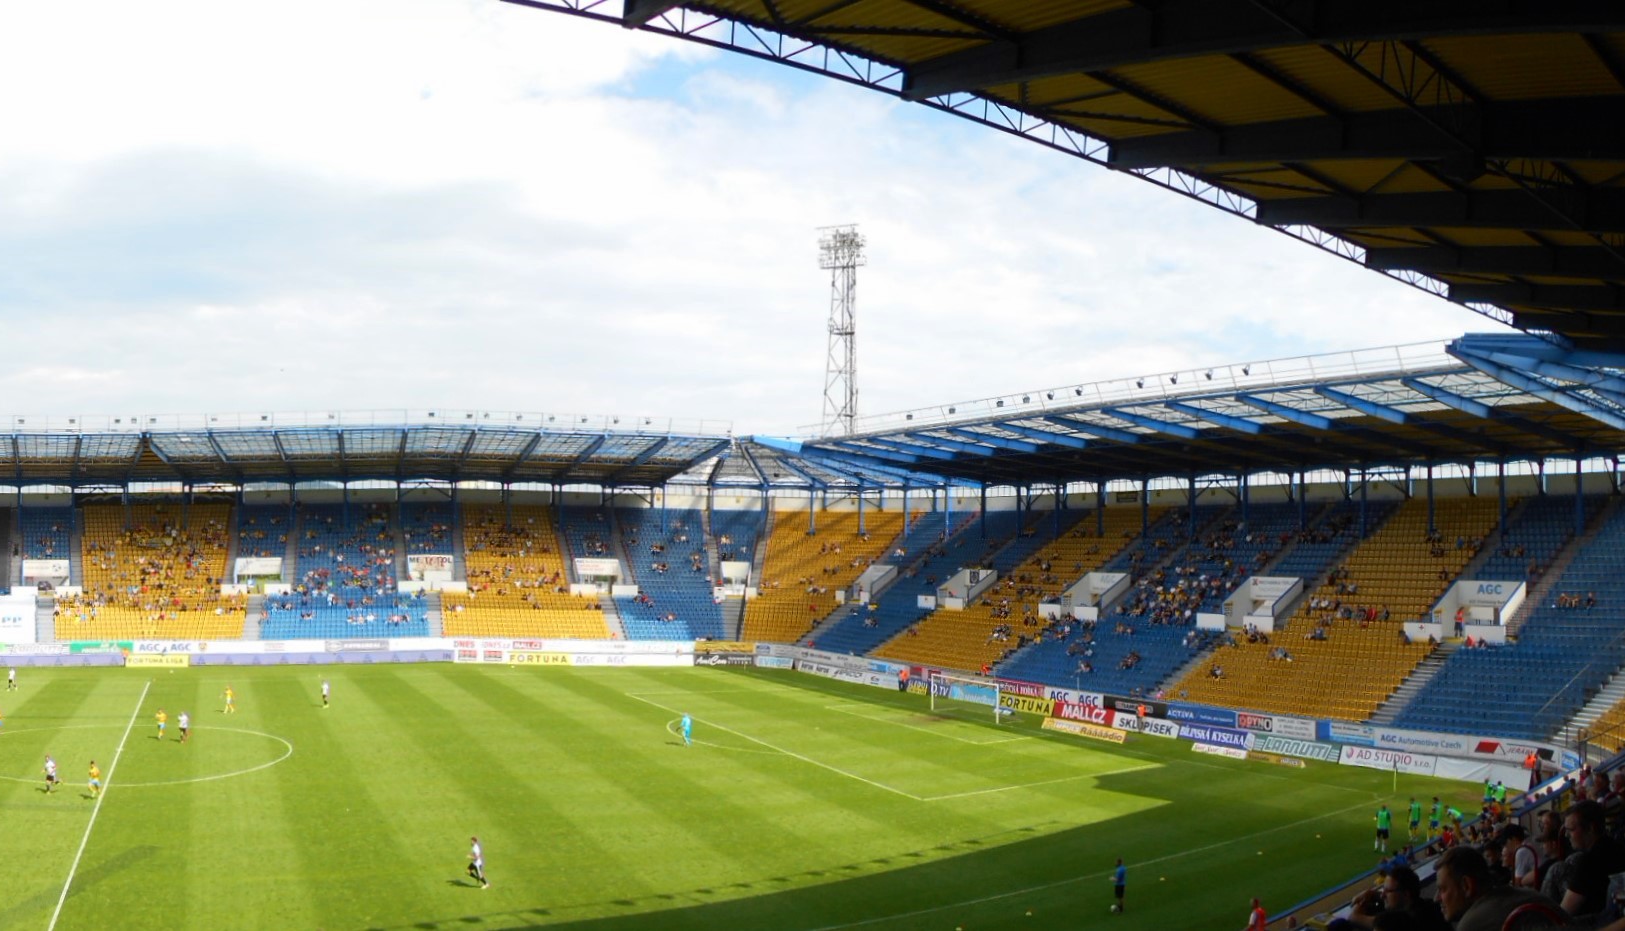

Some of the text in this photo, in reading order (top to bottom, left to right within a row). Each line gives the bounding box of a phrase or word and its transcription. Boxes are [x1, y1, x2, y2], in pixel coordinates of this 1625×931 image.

[1477, 584, 1502, 595] AGC
[139, 643, 191, 651] AGC AGC
[509, 654, 568, 663] FORTUNA
[1000, 696, 1050, 714] FORTUNA
[1050, 690, 1098, 706] AGC AGC
[1061, 705, 1106, 723] MALL.CZ
[1211, 732, 1244, 746] KYSELKA
[1380, 734, 1462, 750] AGC Automotive Czech
[1356, 750, 1372, 761] AD
[1373, 752, 1412, 766] STUDIO
